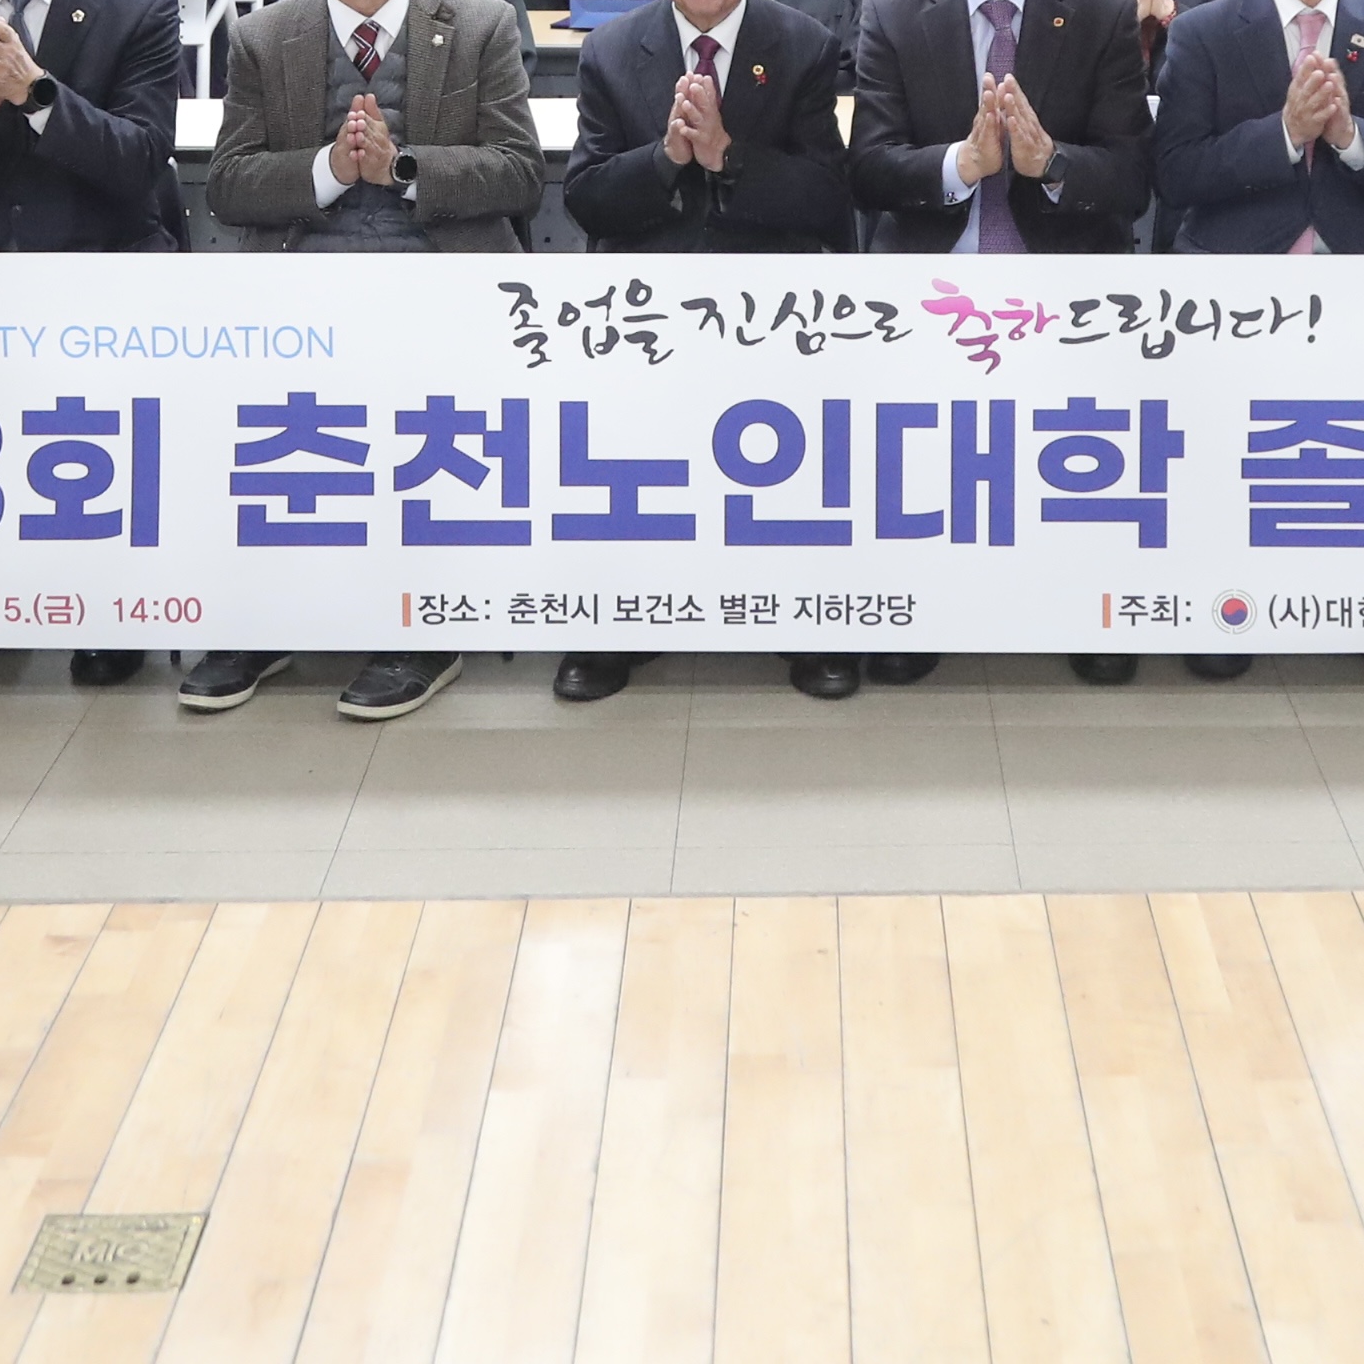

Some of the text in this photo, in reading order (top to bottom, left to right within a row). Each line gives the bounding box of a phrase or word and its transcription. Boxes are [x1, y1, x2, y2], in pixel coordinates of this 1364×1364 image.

[498, 278, 674, 369] 졸업을
[680, 290, 913, 356] 진심으로
[60, 325, 334, 359] GRADUATION
[229, 392, 1185, 549] 춘천노인대학
[4, 593, 85, 625] 5.(금)
[113, 596, 202, 624] 14:00
[418, 593, 917, 627] 장소: 춘천시 보건소 별관 지하강당
[1117, 594, 1192, 627] 주최:
